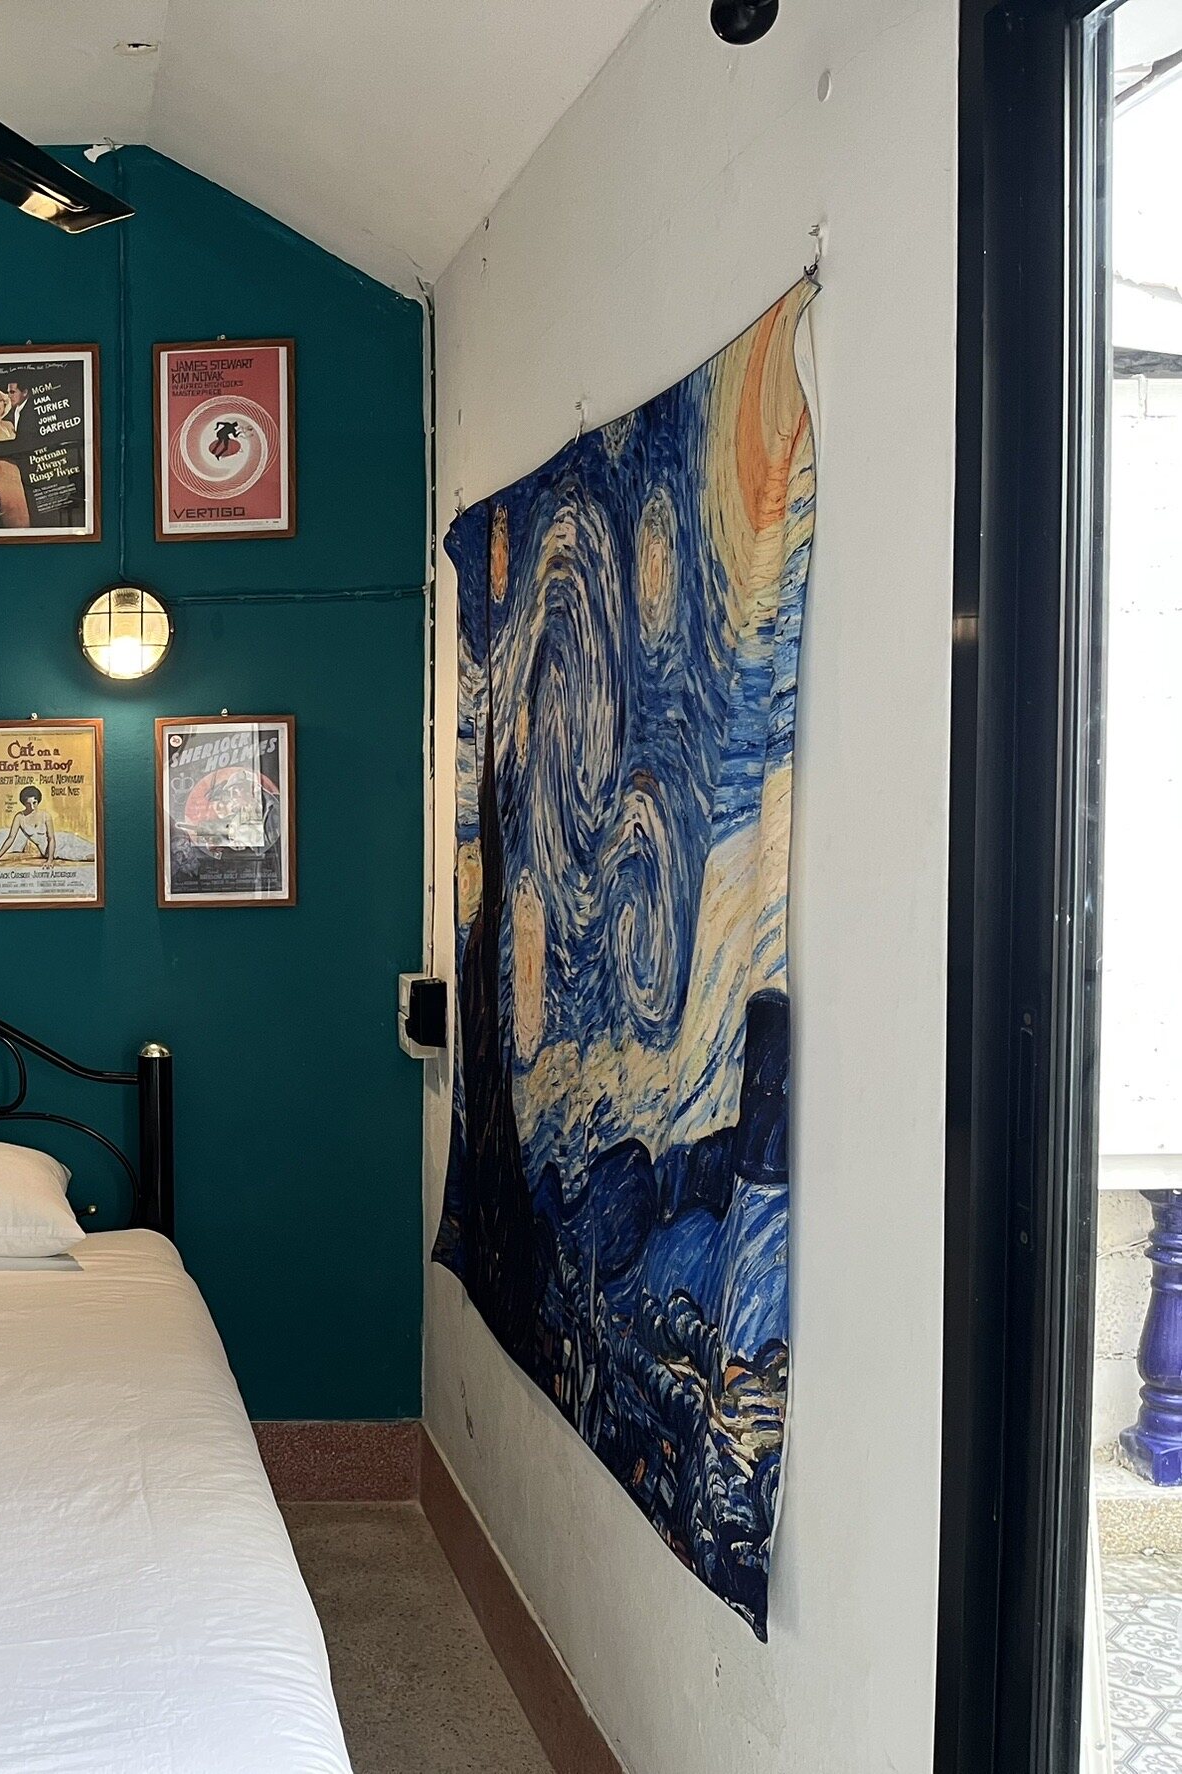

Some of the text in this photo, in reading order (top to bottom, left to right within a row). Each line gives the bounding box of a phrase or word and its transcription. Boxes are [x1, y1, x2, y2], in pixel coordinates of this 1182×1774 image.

[171, 359, 254, 372] JAMES STEWART
[171, 371, 224, 384] KIM NOVAK
[34, 396, 51, 405] LANA
[34, 399, 70, 415] TURNER
[38, 415, 57, 425] JOHN
[40, 416, 81, 436] GARFIELD
[29, 448, 67, 464] Postman
[36, 457, 67, 472] Always
[29, 471, 54, 483] Rings
[173, 507, 245, 519] VERTIGO
[8, 740, 60, 759] Cat on a
[170, 732, 253, 768] SHERLOCK
[204, 737, 278, 772] HOLMES
[20, 760, 42, 771] Tin
[43, 760, 73, 773] Roof
